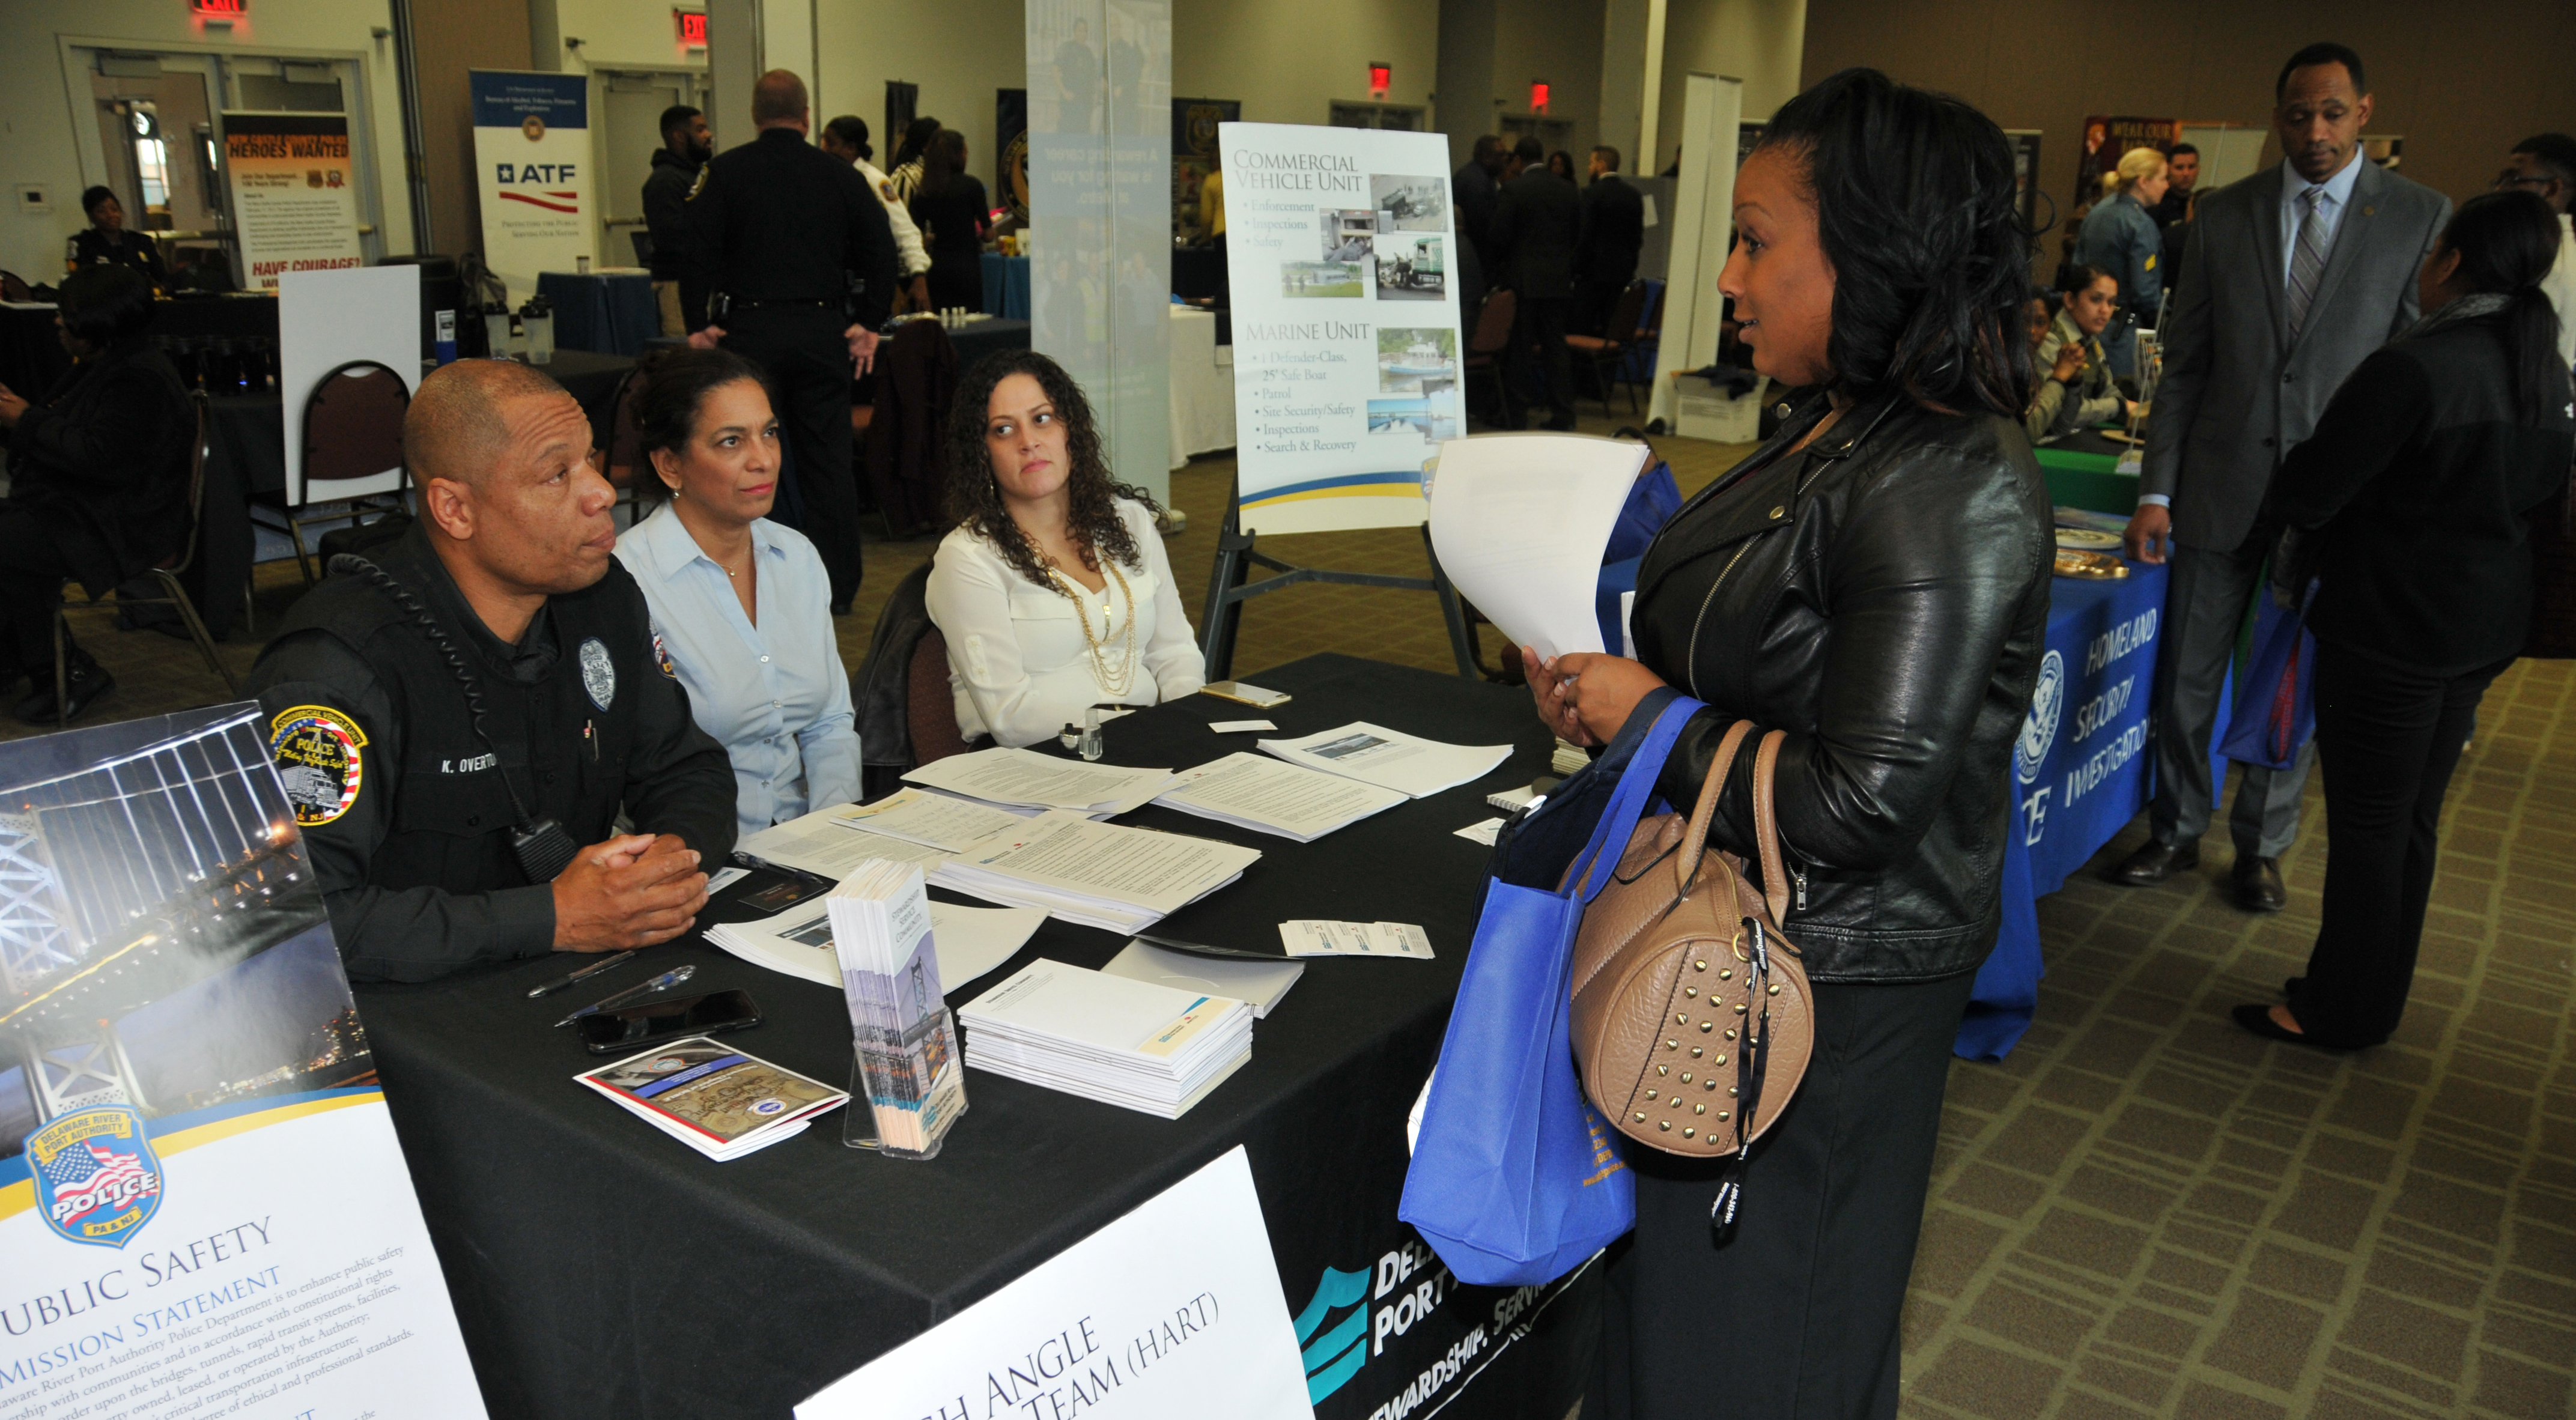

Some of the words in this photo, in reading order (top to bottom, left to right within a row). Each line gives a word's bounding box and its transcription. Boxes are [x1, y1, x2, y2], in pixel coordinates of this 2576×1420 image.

[229, 143, 287, 158] HEROES
[291, 144, 348, 158] WANTED
[1234, 149, 1358, 171] COMMERCIAL
[520, 164, 575, 183] ATF
[1235, 169, 1313, 190] VEHICLE
[1318, 172, 1362, 192] UNIT
[1252, 199, 1314, 211] Enforcement
[1253, 218, 1308, 232] Inspections
[1254, 235, 1283, 250] Safety
[253, 261, 288, 276] HAVE
[1246, 323, 1320, 341] MARINE
[1325, 321, 1370, 339] UNIT
[1269, 350, 1347, 363] Defender-Class,
[1281, 368, 1302, 381] Safe
[1304, 368, 1326, 380] Boat
[1262, 387, 1291, 399] Patrol
[1263, 405, 1282, 417] Site
[1284, 403, 1355, 419] Security/Safety
[1264, 423, 1319, 437] Inspections
[1265, 440, 1298, 452] Search
[1299, 439, 1310, 451] &
[1314, 437, 1356, 453] Recovery
[2085, 608, 2157, 677] HOMELAND
[2073, 675, 2135, 743] SECURITY
[296, 738, 335, 756] POLICE
[442, 760, 454, 773] K.
[309, 813, 324, 821] NJ
[40, 1118, 90, 1144] DELAWARE
[93, 1114, 121, 1124] RIVER
[44, 1133, 68, 1153] PORT
[71, 1123, 124, 1141] AUTHORITY
[52, 1172, 158, 1221] POLICE
[93, 1225, 108, 1234] PA
[120, 1215, 134, 1225] NJ
[140, 1216, 272, 1287] SAFETY
[133, 1266, 281, 1337] STATEMENT
[1374, 1268, 1448, 1356] PORT
[41, 1374, 75, 1392] River
[78, 1362, 106, 1379] Port
[109, 1337, 166, 1367] Authority
[169, 1326, 203, 1344] Police
[205, 1297, 272, 1330] Department
[287, 1288, 297, 1299] to
[300, 1274, 342, 1293] enhance
[344, 1256, 376, 1279] public
[377, 1246, 404, 1263] safety
[50, 1390, 79, 1407] with
[83, 1361, 162, 1396] communities
[164, 1347, 186, 1365] and
[189, 1344, 201, 1355] in
[204, 1326, 263, 1349] accordance
[266, 1307, 291, 1323] with
[293, 1276, 363, 1314] constitutional
[365, 1267, 393, 1286] rights
[1128, 1291, 1219, 1377] (HART)
[94, 1392, 126, 1412] upon
[129, 1384, 149, 1397] the
[151, 1367, 198, 1389] bridges,
[199, 1344, 245, 1368] tunnels,
[247, 1330, 275, 1350] rapid
[278, 1317, 311, 1338] transit
[314, 1301, 356, 1324] systems,
[357, 1282, 401, 1306] facilities,
[177, 1373, 216, 1396] leased,
[219, 1370, 230, 1380] or
[233, 1346, 281, 1375] operated
[282, 1340, 296, 1356] by
[299, 1333, 320, 1347] the
[318, 1313, 371, 1341] Authority;
[205, 1365, 284, 1404] transportation
[286, 1334, 359, 1371] infrastructure;
[229, 1398, 240, 1412] of
[243, 1383, 279, 1407] ethical
[282, 1374, 303, 1391] and
[304, 1350, 364, 1382] professional
[366, 1329, 415, 1355] standards.
[986, 1316, 1100, 1420] ANGLE
